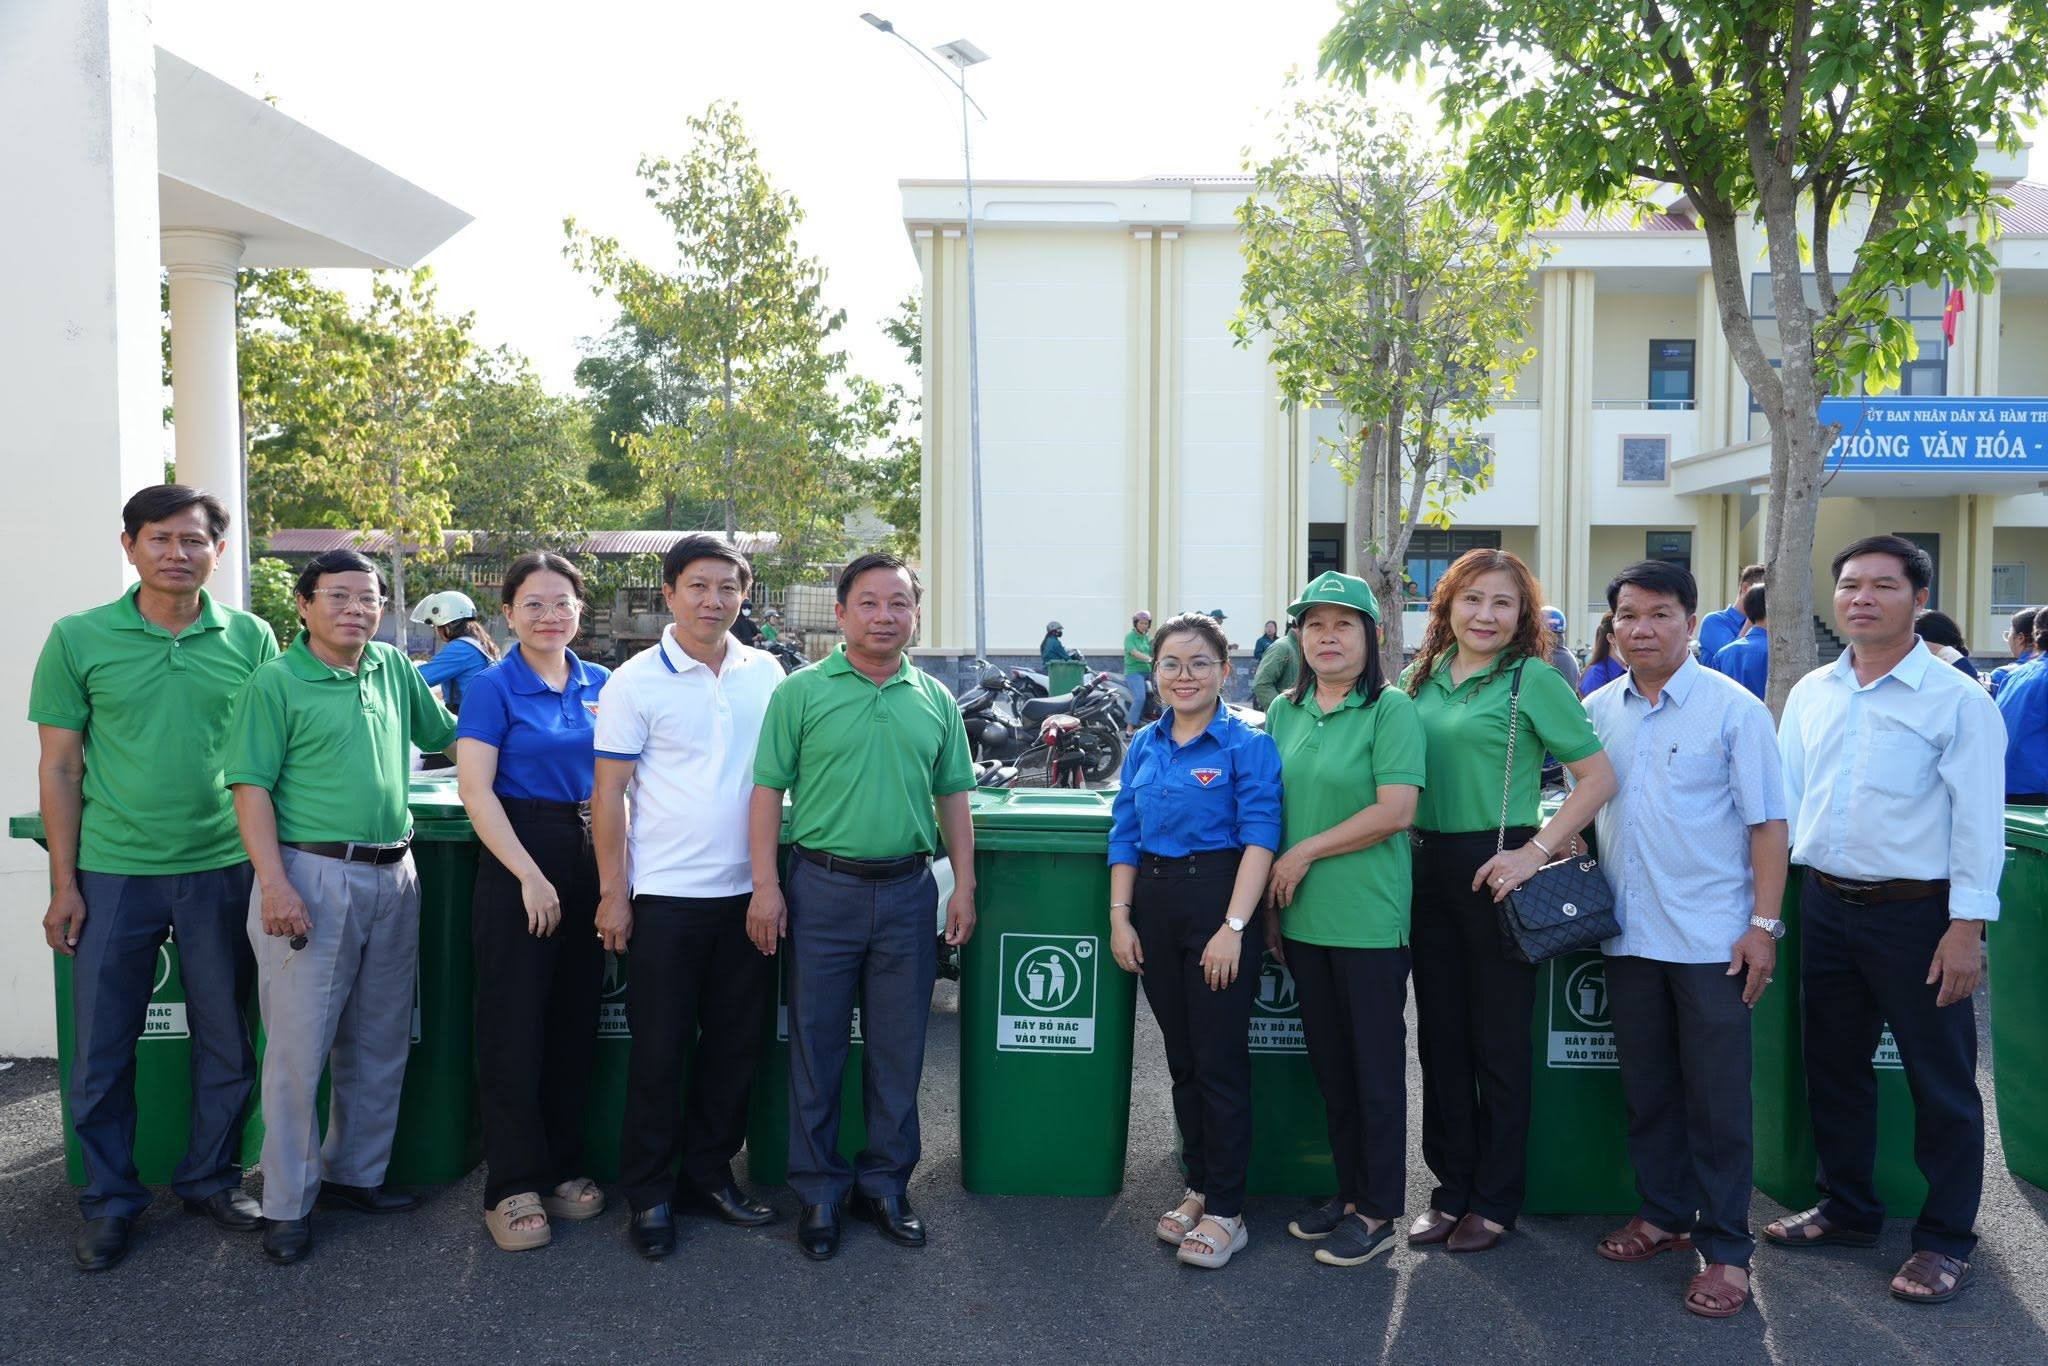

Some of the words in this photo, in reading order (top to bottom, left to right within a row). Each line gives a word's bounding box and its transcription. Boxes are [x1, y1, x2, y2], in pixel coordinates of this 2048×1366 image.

[1887, 410, 1911, 422] BAN
[1913, 408, 1947, 422] NHÂN
[1950, 408, 1976, 422] DÂN
[1978, 408, 1996, 422] XÃ
[1999, 408, 2028, 422] HÀM
[1920, 430, 1968, 458] VĂN
[1974, 429, 2027, 458] HÓA
[1057, 1020, 1079, 1031] RÁC
[1015, 1032, 1036, 1043] VÀO
[1040, 1033, 1077, 1044] THÙNG
